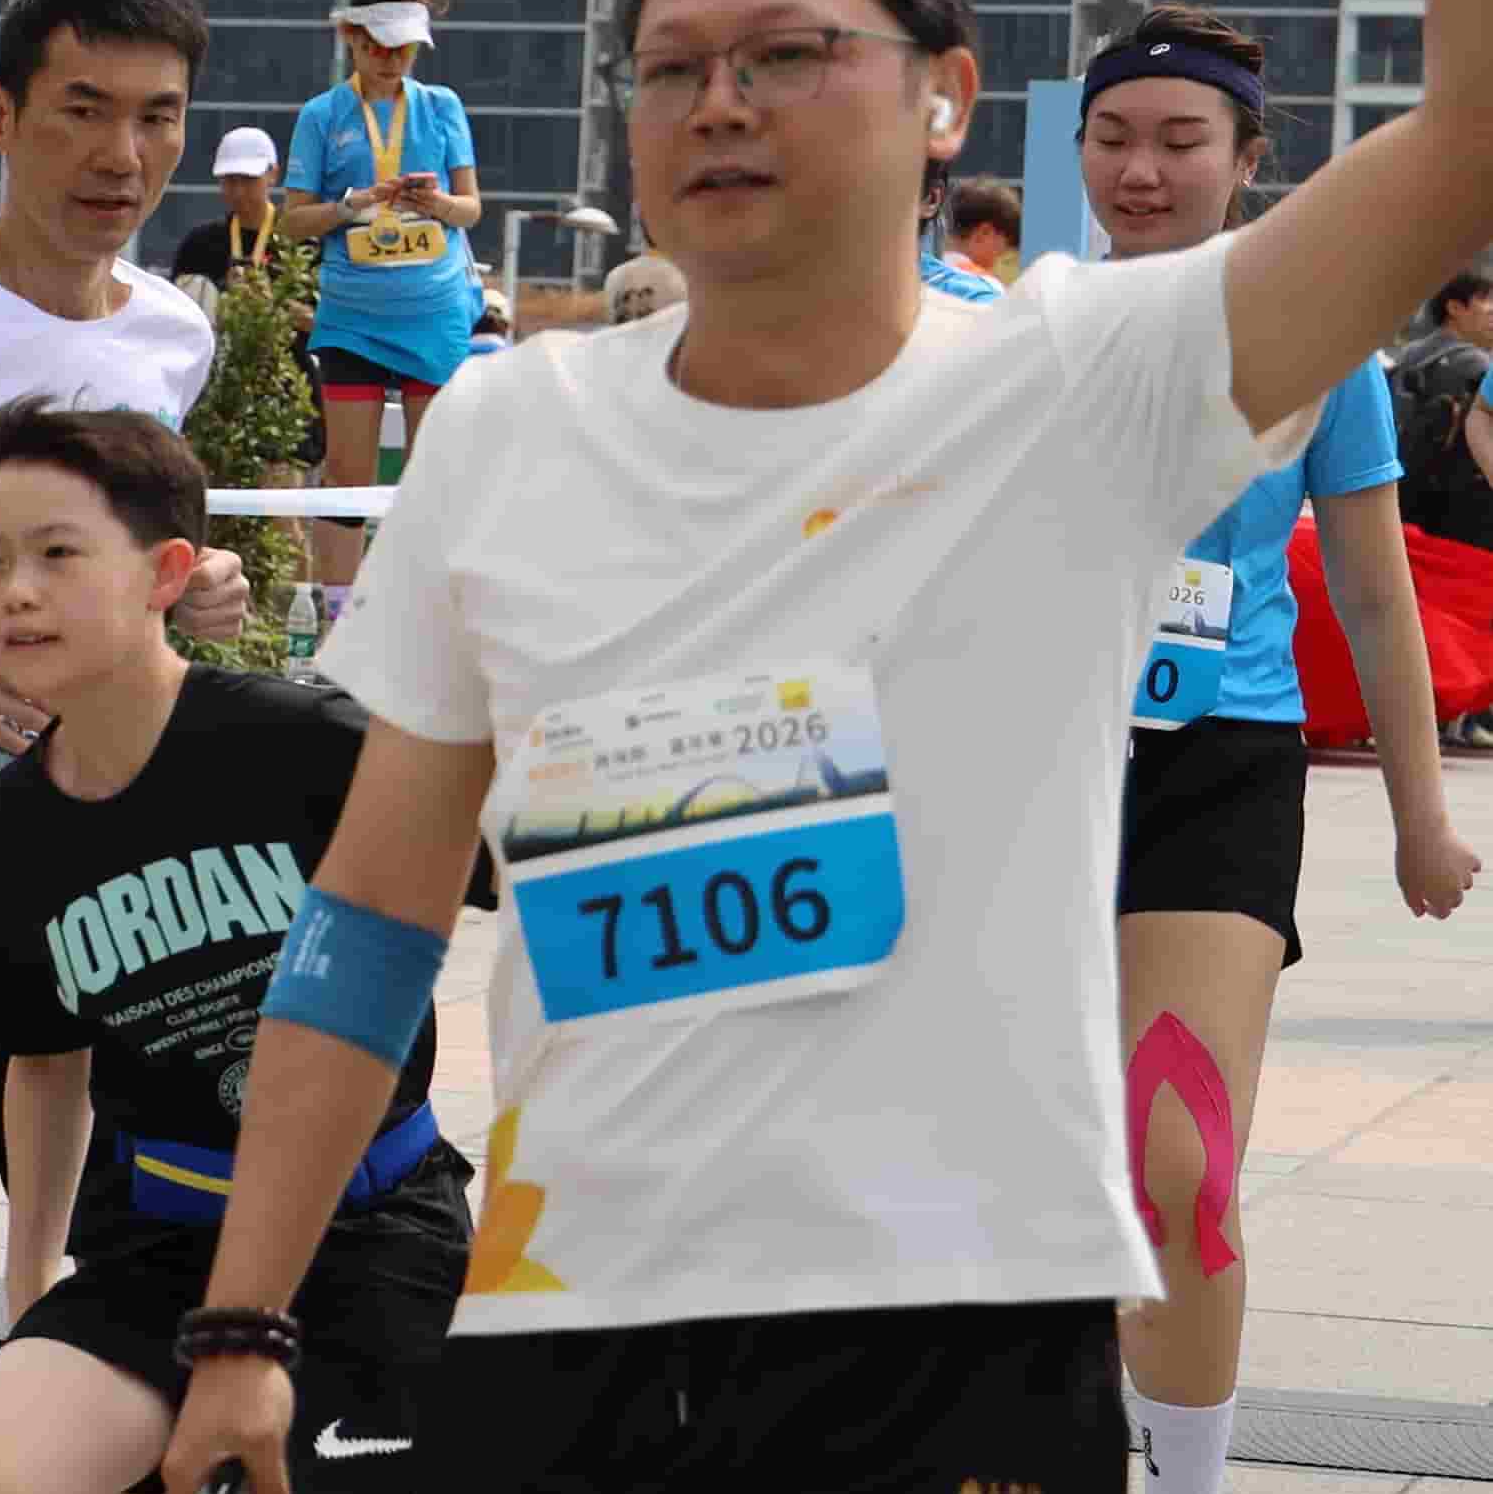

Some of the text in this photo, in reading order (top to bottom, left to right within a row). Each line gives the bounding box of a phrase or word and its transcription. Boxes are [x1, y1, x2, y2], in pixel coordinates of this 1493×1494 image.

[735, 713, 828, 757] 2026
[45, 842, 301, 1015] JORDAN
[577, 857, 832, 980] 7106
